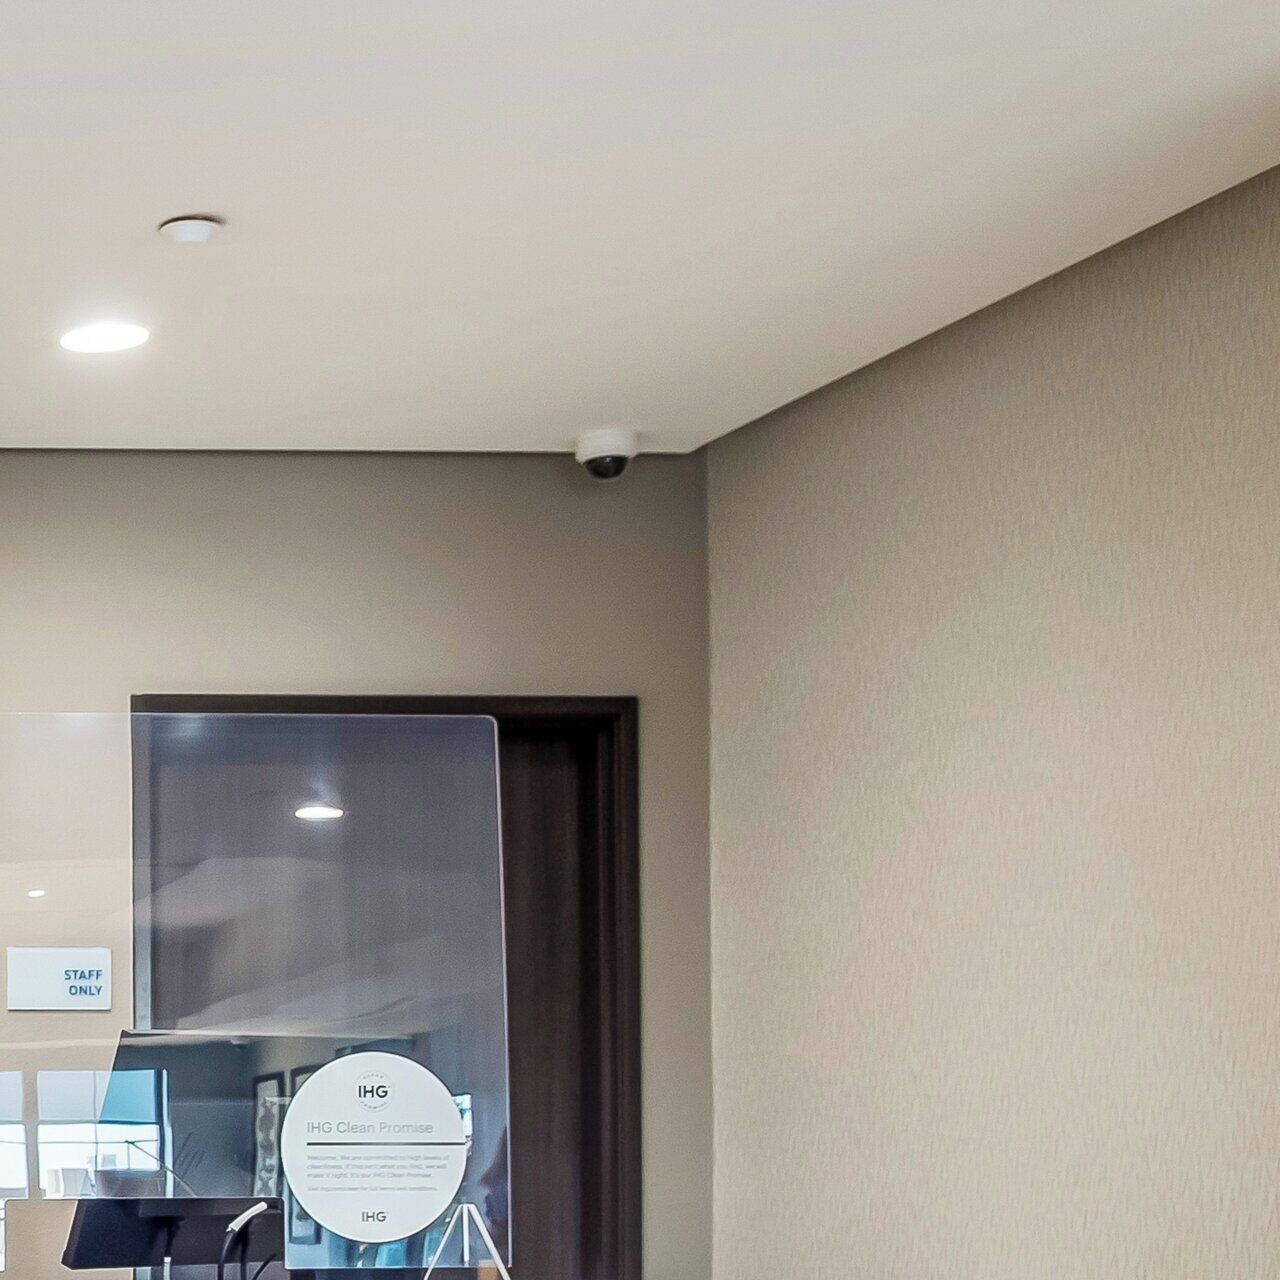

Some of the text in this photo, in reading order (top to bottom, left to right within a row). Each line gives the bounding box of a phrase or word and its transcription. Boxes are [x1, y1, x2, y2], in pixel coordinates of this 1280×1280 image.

[64, 969, 103, 981] STAFF
[69, 984, 103, 996] ONLY
[358, 1085, 388, 1098] IHG
[306, 1121, 433, 1134] IHG Clean Promise
[361, 1211, 387, 1222] IHG
